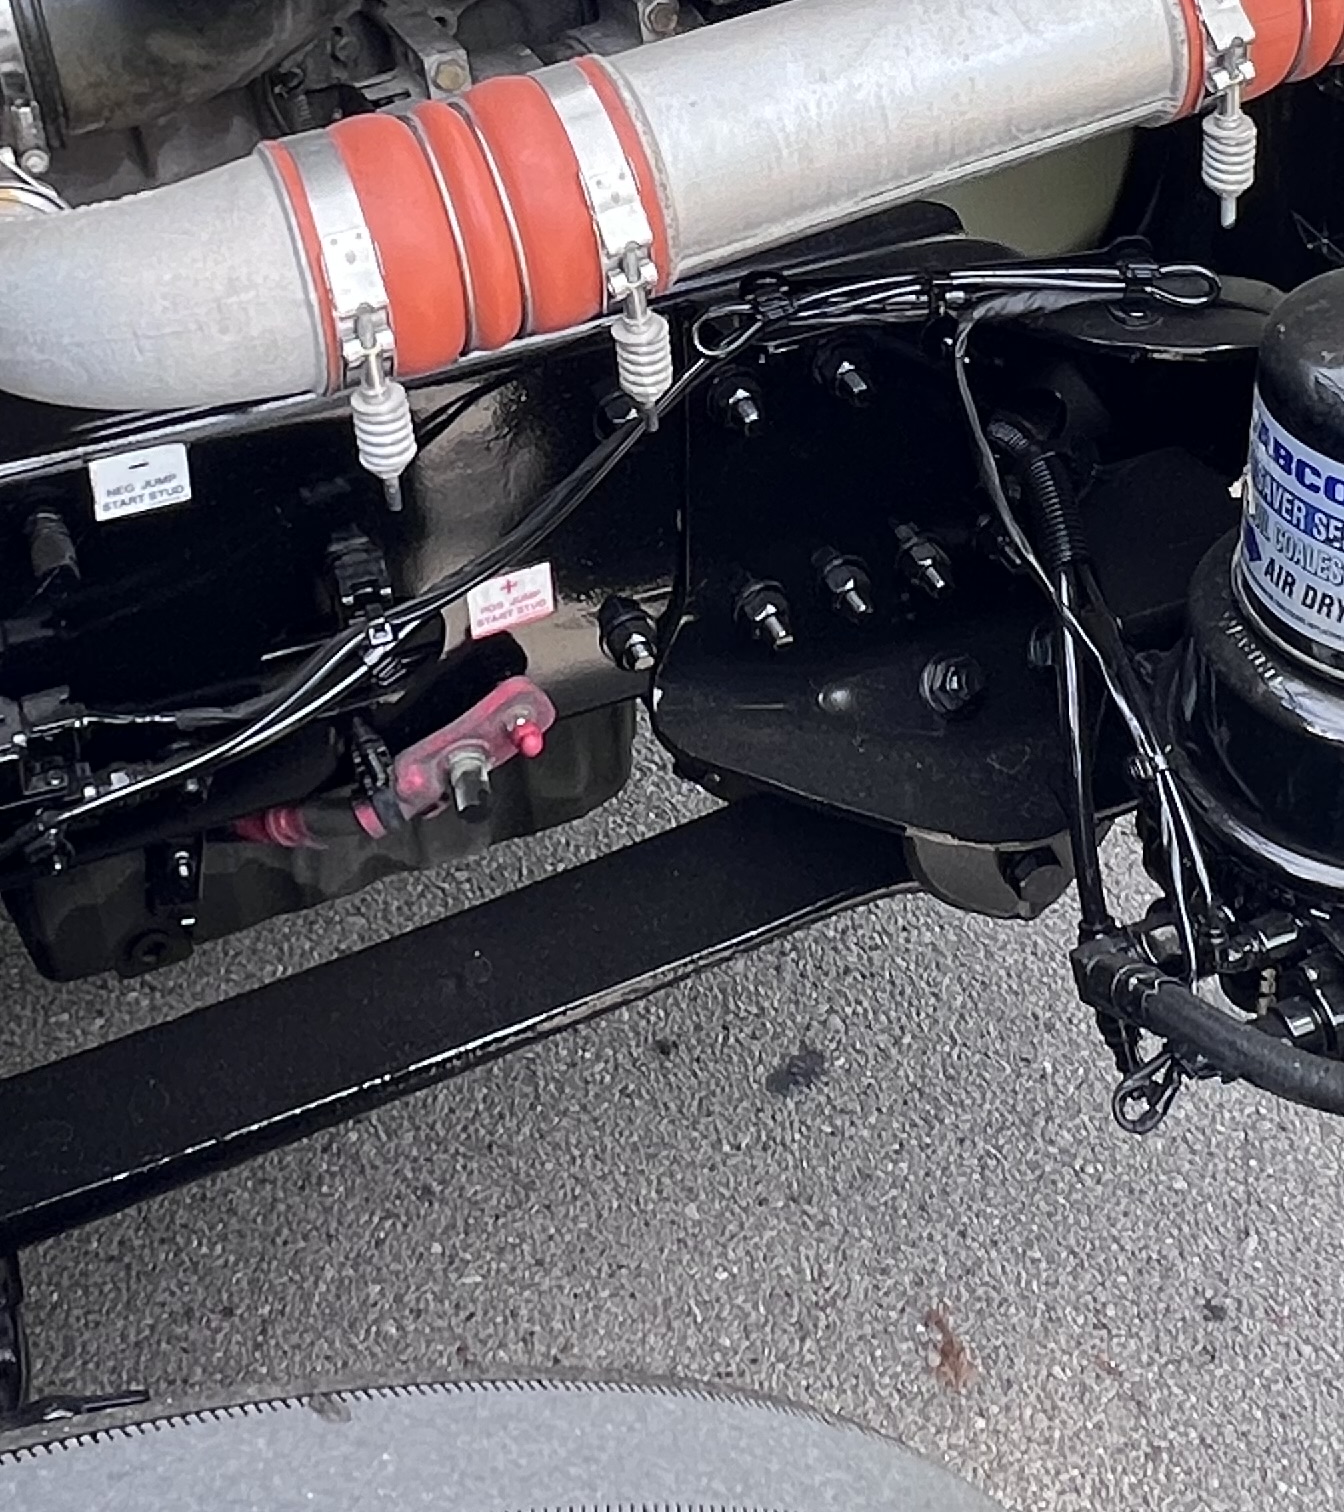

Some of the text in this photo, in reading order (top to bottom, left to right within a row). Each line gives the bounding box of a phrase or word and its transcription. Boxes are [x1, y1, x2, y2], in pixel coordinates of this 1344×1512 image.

[102, 484, 184, 512] START STUD
[107, 473, 177, 497] NEG JUMP
[1264, 557, 1296, 599] AIR
